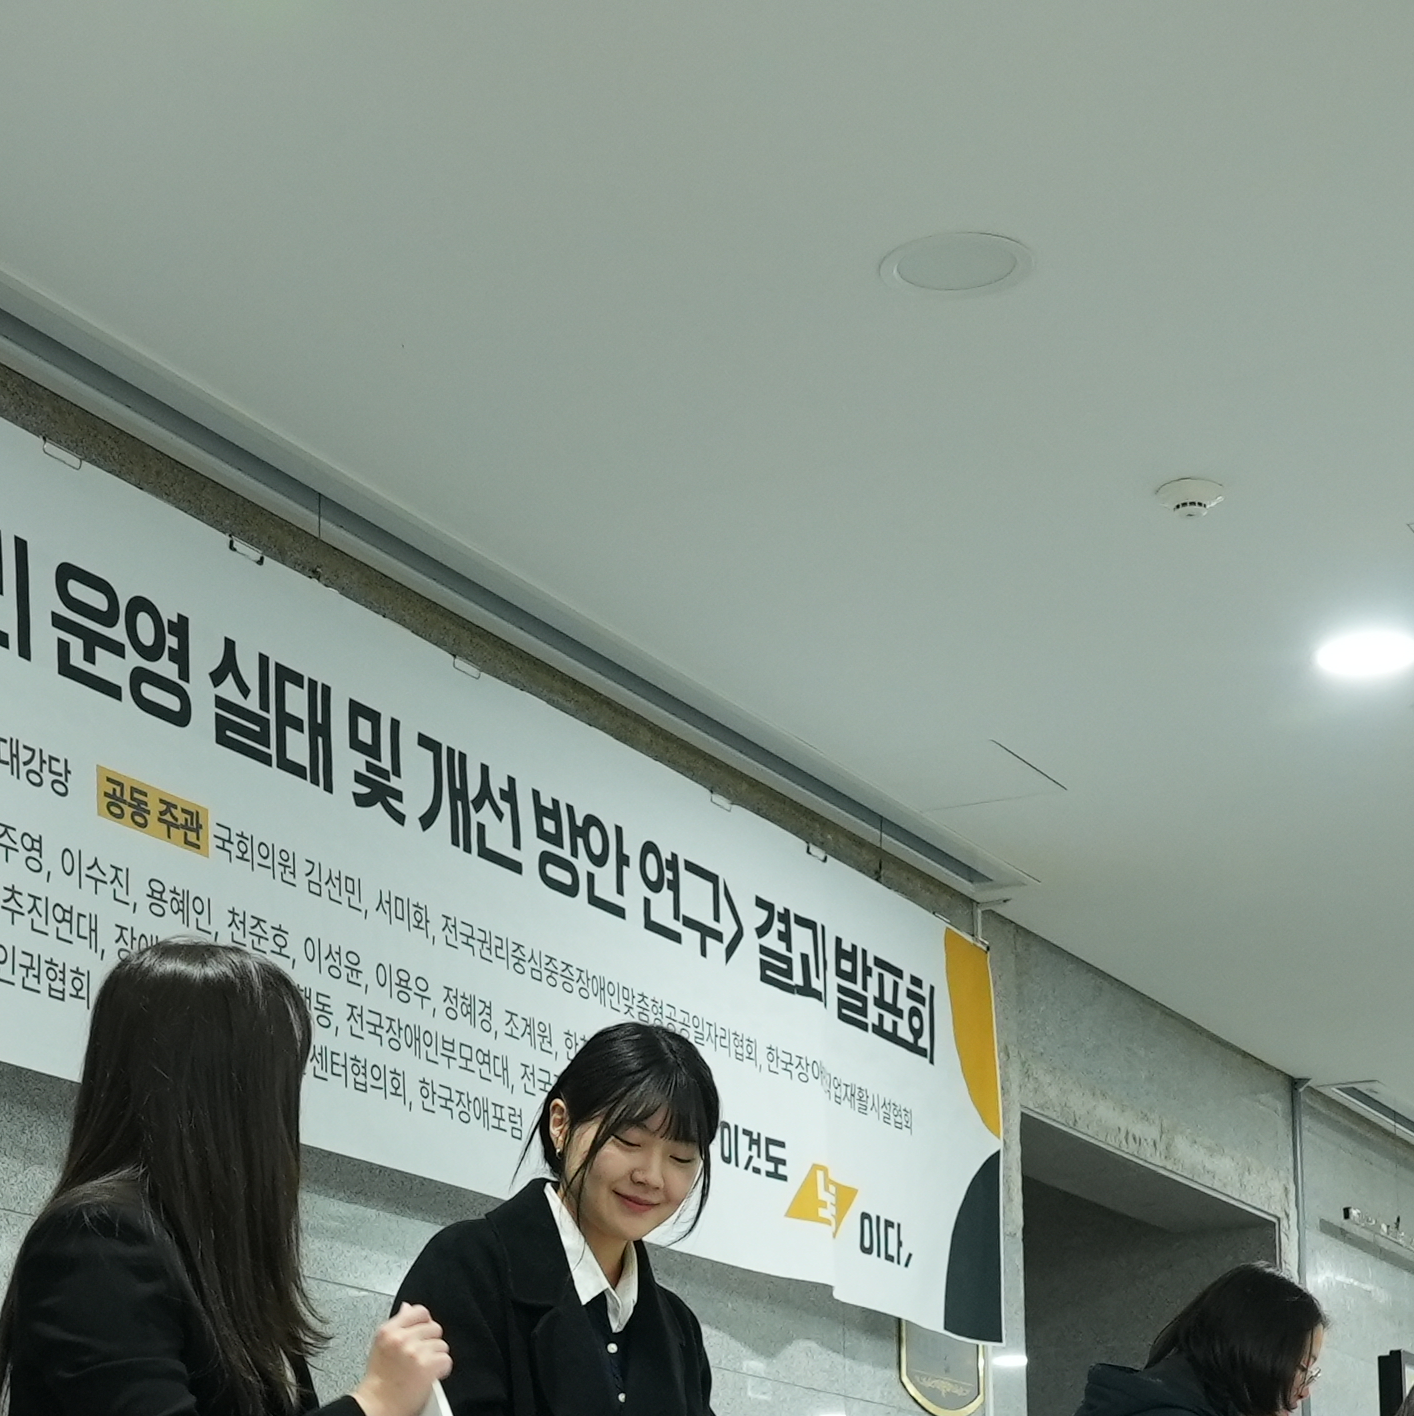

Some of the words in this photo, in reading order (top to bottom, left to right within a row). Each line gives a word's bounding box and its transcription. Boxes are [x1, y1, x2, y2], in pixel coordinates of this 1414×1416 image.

[49, 560, 192, 729] 운영
[208, 636, 333, 795] 실태
[349, 697, 407, 828] 및
[419, 731, 524, 876] 개선
[532, 787, 631, 921] 방안
[639, 840, 744, 965] 연구>
[834, 934, 936, 1067] 발표회
[102, 775, 151, 830] 공동
[157, 795, 203, 851] 주관
[212, 821, 298, 888] 국회의원
[304, 856, 369, 920] 김선민,
[375, 888, 437, 946] 서미화,
[61, 846, 139, 914] 이수진,
[145, 877, 219, 942] 용혜인,
[227, 905, 297, 970] 천준호,
[303, 934, 369, 995] 이성윤,
[375, 962, 437, 1019] 이용우,
[441, 983, 498, 1041] 정혜경,
[504, 1009, 558, 1062] 조계원,
[345, 1001, 515, 1095] 전국장애인부모연대,
[418, 1076, 524, 1141] 한국장애포럼
[719, 1120, 789, 1183] 이것도
[859, 1210, 913, 1268] 이다,
